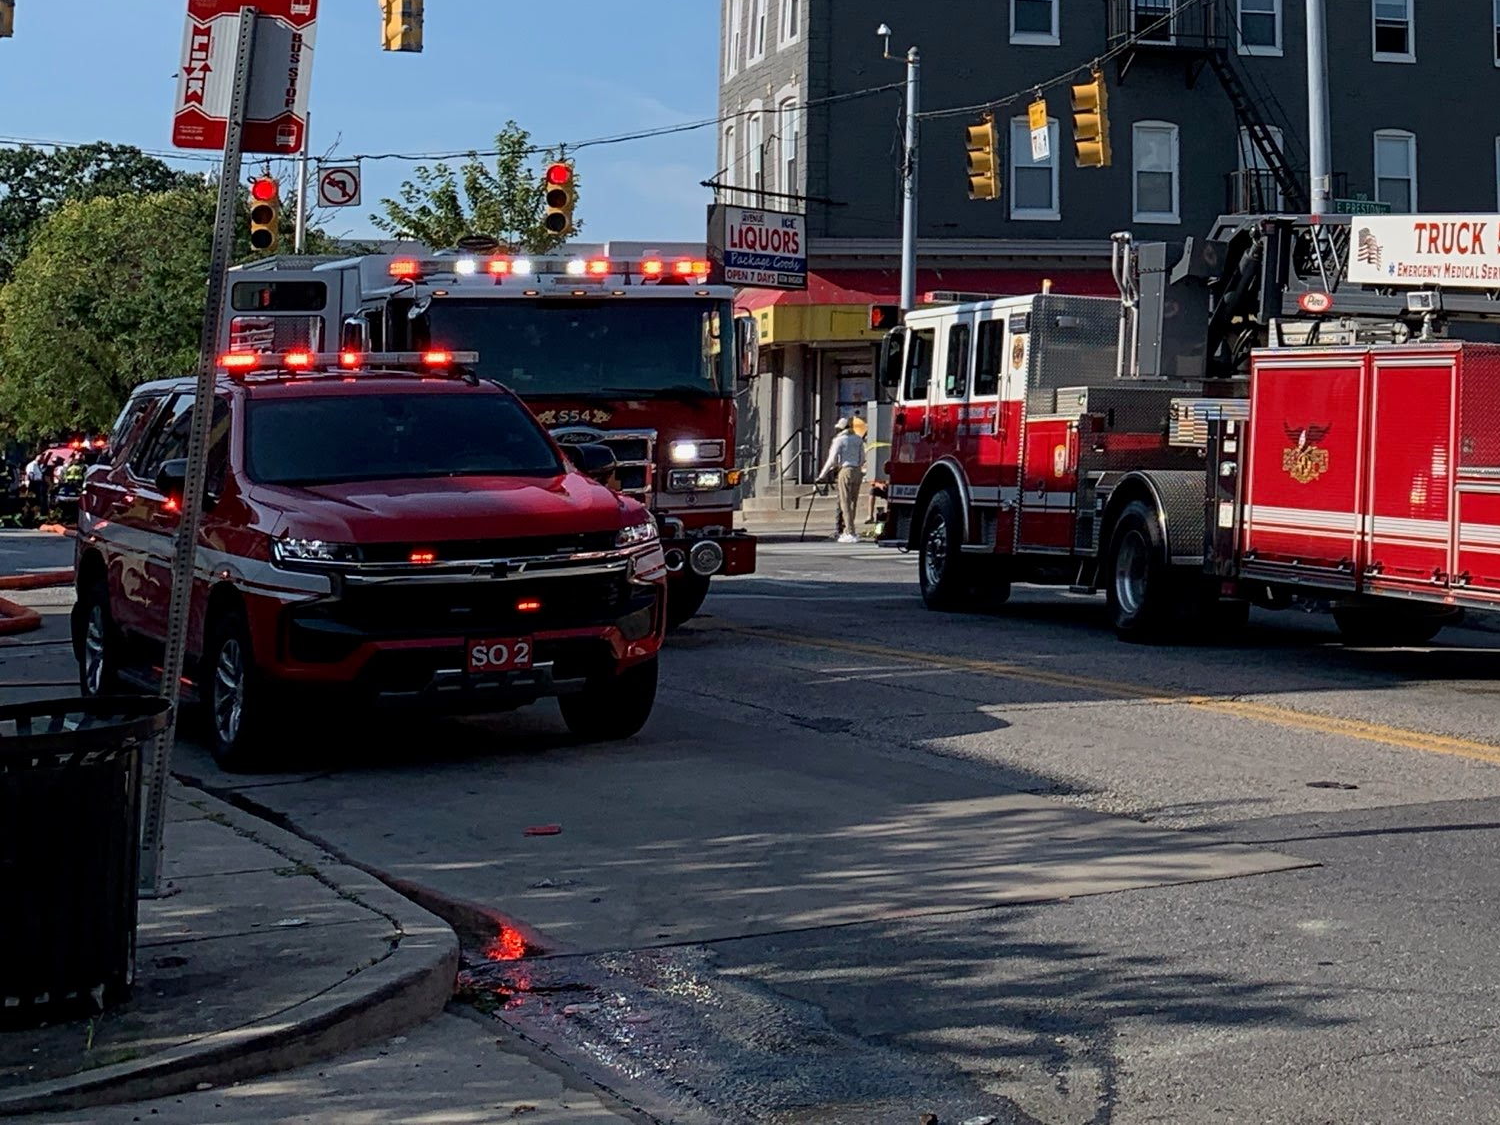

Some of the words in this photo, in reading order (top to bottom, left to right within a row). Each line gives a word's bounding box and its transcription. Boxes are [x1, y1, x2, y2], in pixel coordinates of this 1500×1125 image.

[290, 33, 302, 63] BUS
[285, 67, 298, 108] STOP
[1336, 202, 1342, 213] E
[1345, 202, 1380, 215] PRESTON
[781, 217, 797, 229] ICE
[730, 224, 799, 254] LIQUORS
[1414, 222, 1487, 255] TRUCK
[731, 252, 771, 270] Package
[773, 256, 801, 271] Goods
[1397, 262, 1441, 279] EMERGENCY
[1444, 263, 1481, 279] MEDICAL
[726, 269, 748, 281] OPEN
[750, 271, 755, 281] 7
[757, 273, 776, 284] DAYS
[559, 410, 591, 422] S54
[472, 644, 508, 666] SO
[513, 642, 529, 663] 2
